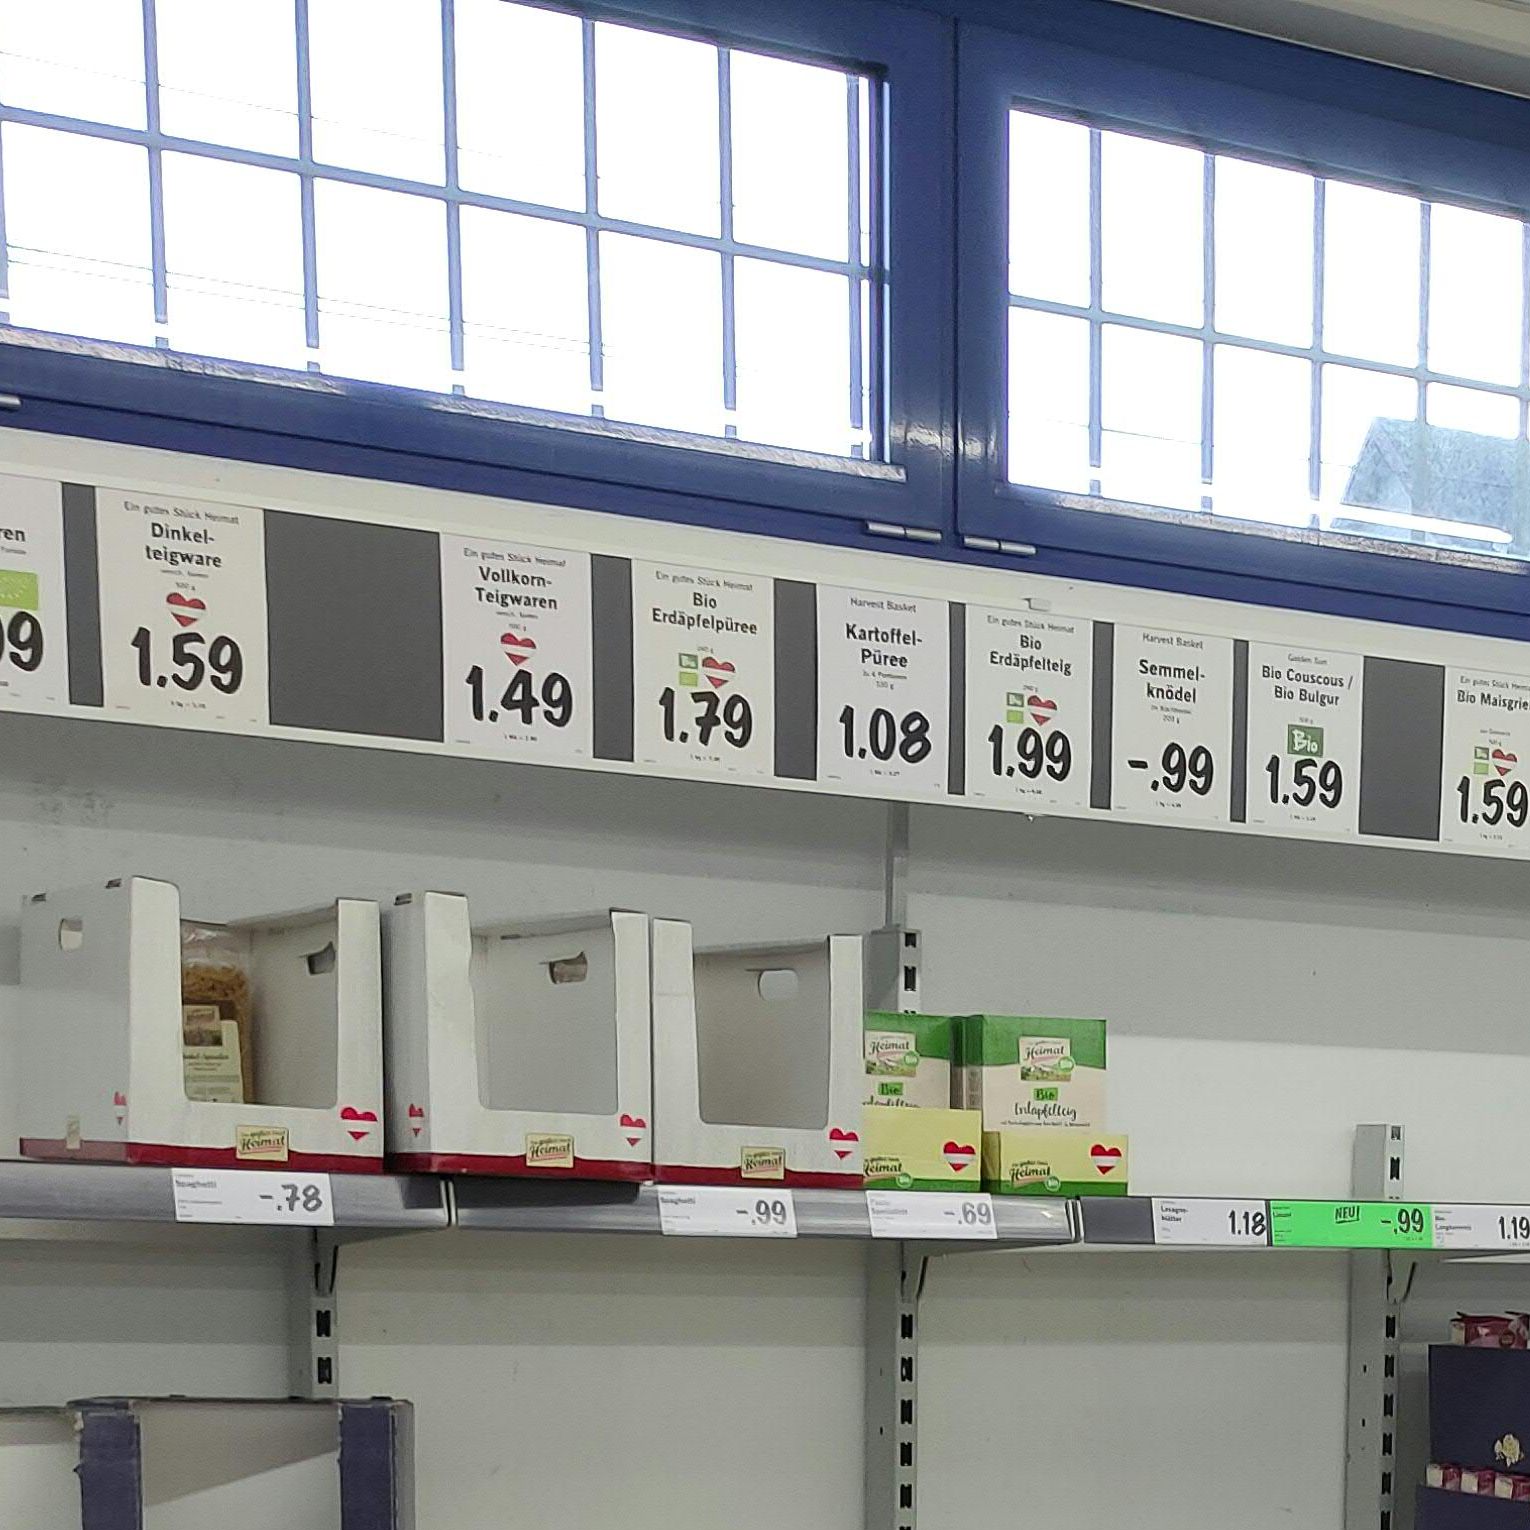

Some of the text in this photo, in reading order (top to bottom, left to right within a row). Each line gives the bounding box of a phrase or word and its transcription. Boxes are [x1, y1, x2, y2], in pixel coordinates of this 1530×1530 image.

[151, 523, 214, 544] Dinkel-
[145, 545, 222, 568] teigware
[479, 566, 552, 588] Vollkorn-
[476, 588, 557, 610] Teigwaren
[693, 592, 717, 608] Bio
[850, 598, 916, 613] Harvest Basket
[652, 608, 757, 635] Erdäpfelpüree
[0, 611, 43, 672] 9
[846, 623, 922, 646] Kartoffel-
[1020, 634, 1041, 650] Bio
[1142, 632, 1203, 650] Harvest Basket
[131, 627, 243, 694] 1.59
[861, 649, 907, 668] Püree
[990, 651, 1072, 676] Erdäpfelteig
[1139, 659, 1205, 681] Semmel-
[1262, 665, 1282, 680] Bio
[1286, 669, 1345, 688] Couscous
[466, 665, 573, 727] 1.49
[1147, 683, 1196, 703] knödel
[1274, 685, 1340, 707] Bio Bulgur
[1457, 690, 1476, 703] Bio
[659, 687, 751, 748] 1.79
[840, 705, 931, 763] 1.08
[988, 724, 1072, 781] 1.99
[1128, 742, 1214, 795] -.99
[1266, 754, 1343, 809] 1.59
[1457, 776, 1528, 827] 1.59
[869, 1041, 910, 1055] Heimat
[1024, 1045, 1064, 1059] Heimat
[1009, 1166, 1050, 1181] Heimat
[259, 1183, 322, 1212] -.78
[736, 1200, 786, 1225] -.99
[944, 1202, 992, 1225] -.69
[1229, 1210, 1265, 1236] 1.18
[1335, 1206, 1360, 1221] NEU!
[1381, 1208, 1424, 1234] -.99
[1499, 1216, 1530, 1240] 1.19
